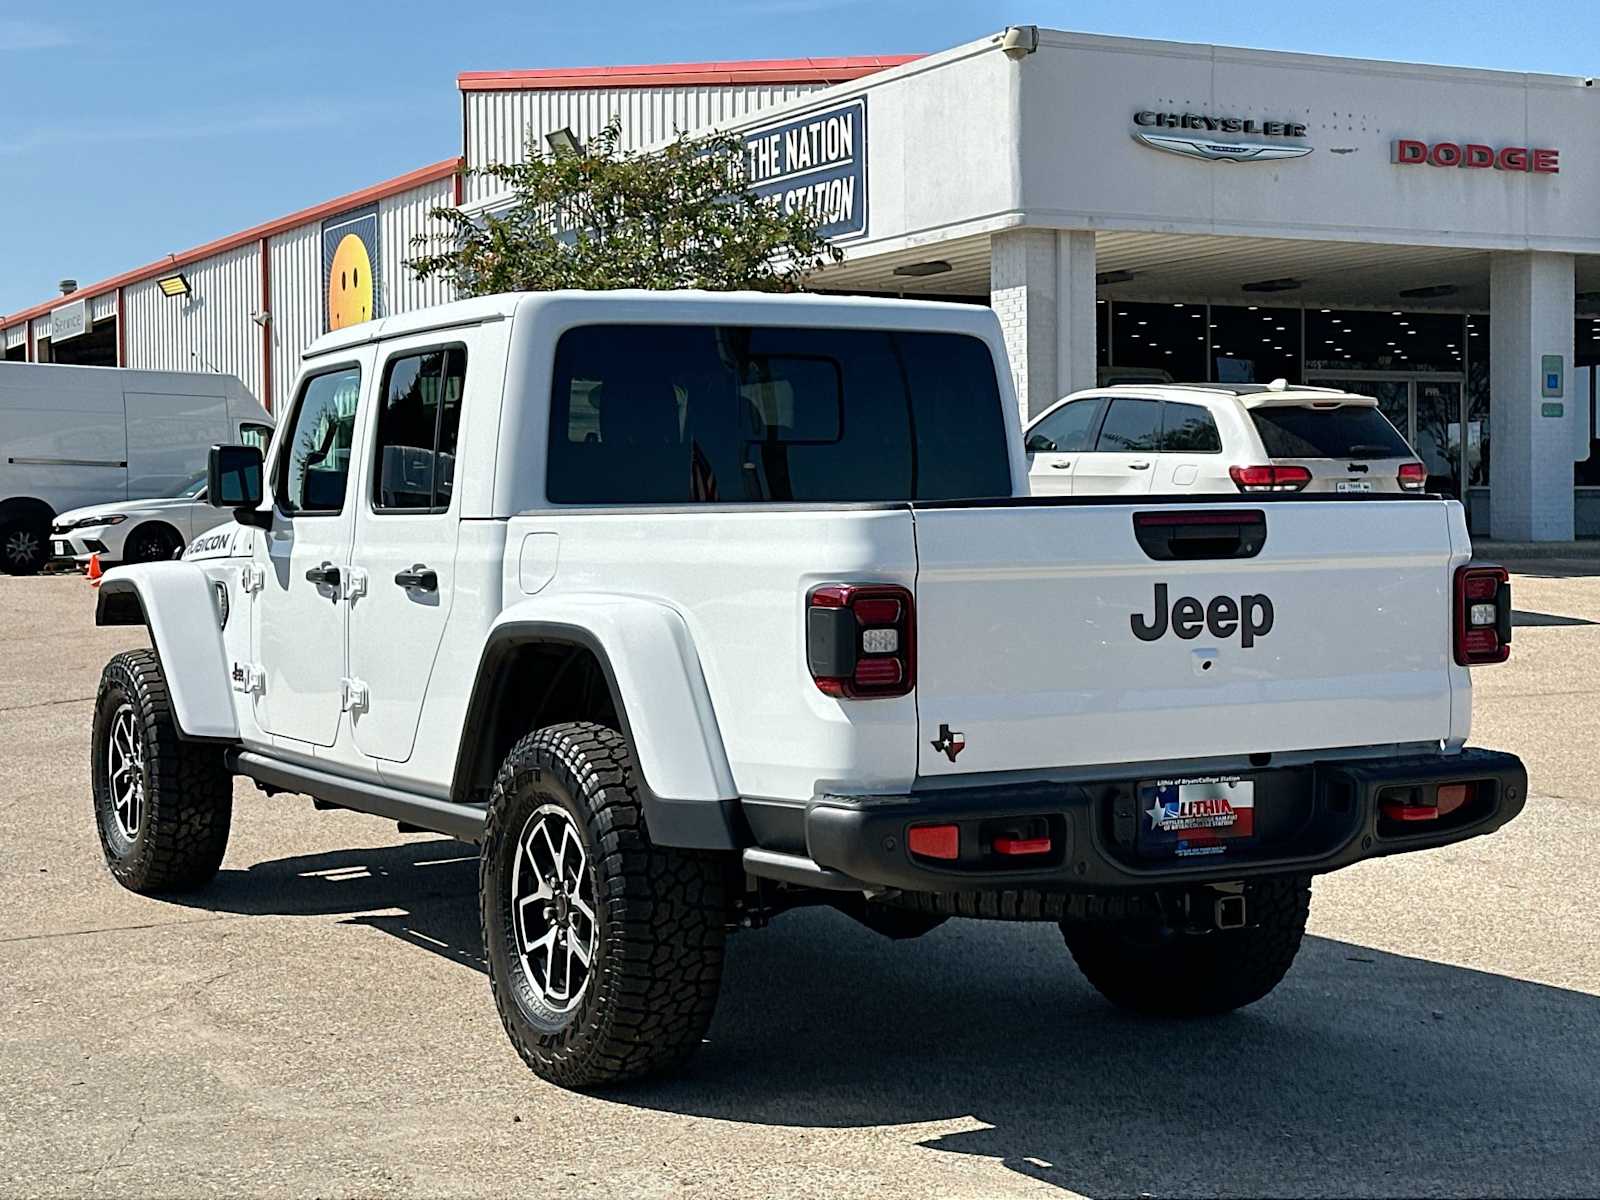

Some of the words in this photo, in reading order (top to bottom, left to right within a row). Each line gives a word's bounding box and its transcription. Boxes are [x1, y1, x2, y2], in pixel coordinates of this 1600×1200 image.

[1133, 111, 1306, 138] CHRYSLER
[747, 133, 781, 181] THE
[785, 112, 853, 172] NATION
[1393, 140, 1560, 174] DODGE
[1130, 582, 1275, 649] Jeep
[1157, 779, 1174, 787] Lithia
[1180, 800, 1234, 817] LITHIA
